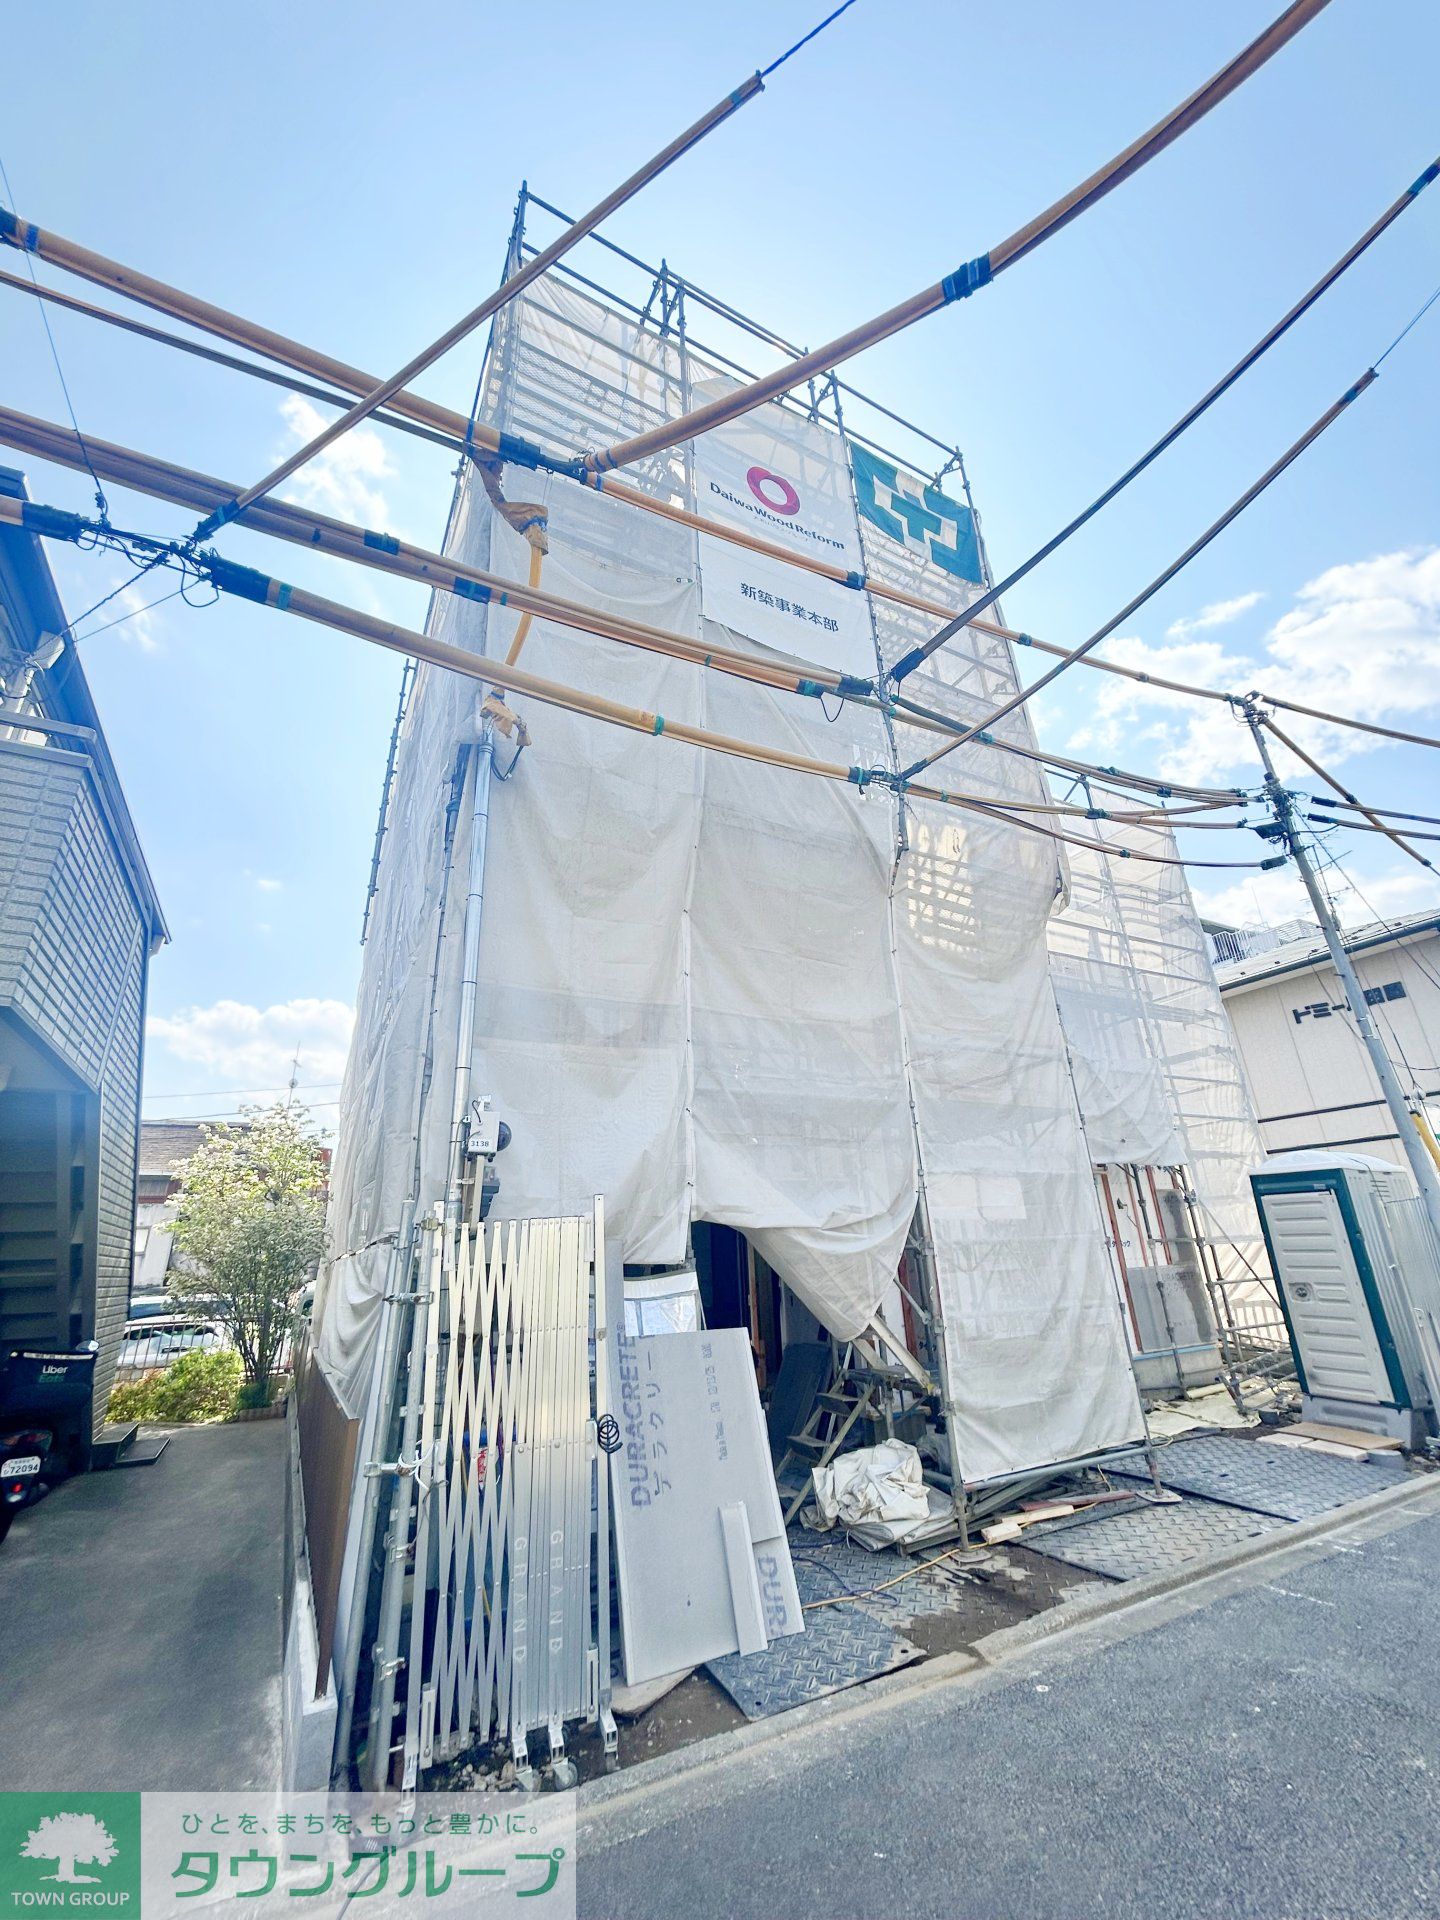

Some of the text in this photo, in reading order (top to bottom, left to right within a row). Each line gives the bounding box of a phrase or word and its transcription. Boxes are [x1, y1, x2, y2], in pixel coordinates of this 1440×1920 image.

[709, 481, 845, 550] DaiwaWoodReform
[740, 582, 839, 632] 新築事業本部
[39, 1374, 65, 1383] Eats
[42, 1365, 69, 1374] Uber
[10, 1463, 39, 1475] 72094
[513, 1536, 528, 1662] GRAND
[549, 1530, 563, 1653] GRAND
